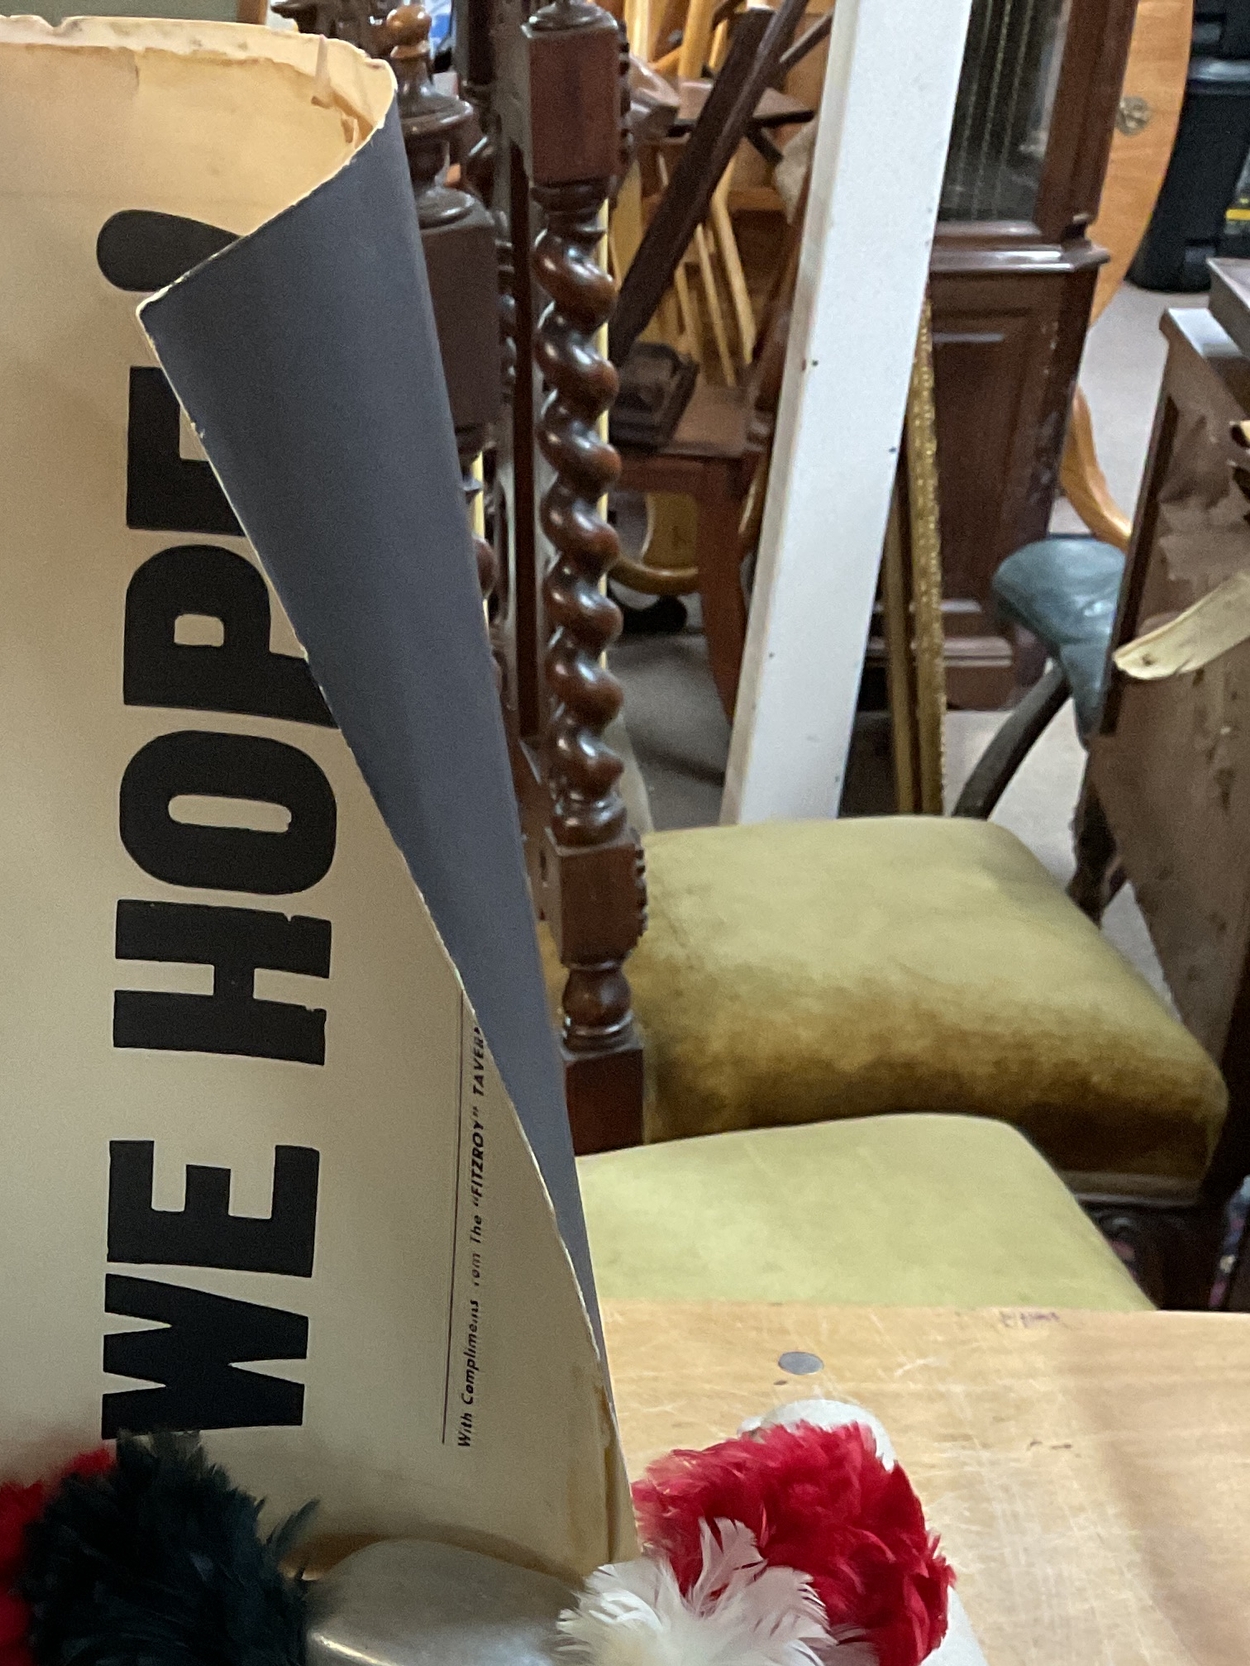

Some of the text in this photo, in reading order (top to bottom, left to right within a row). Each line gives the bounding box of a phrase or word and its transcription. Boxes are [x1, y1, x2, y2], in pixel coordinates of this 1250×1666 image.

[100, 1138, 321, 1441] WE
[457, 1412, 473, 1447] With
[469, 1214, 483, 1244] The
